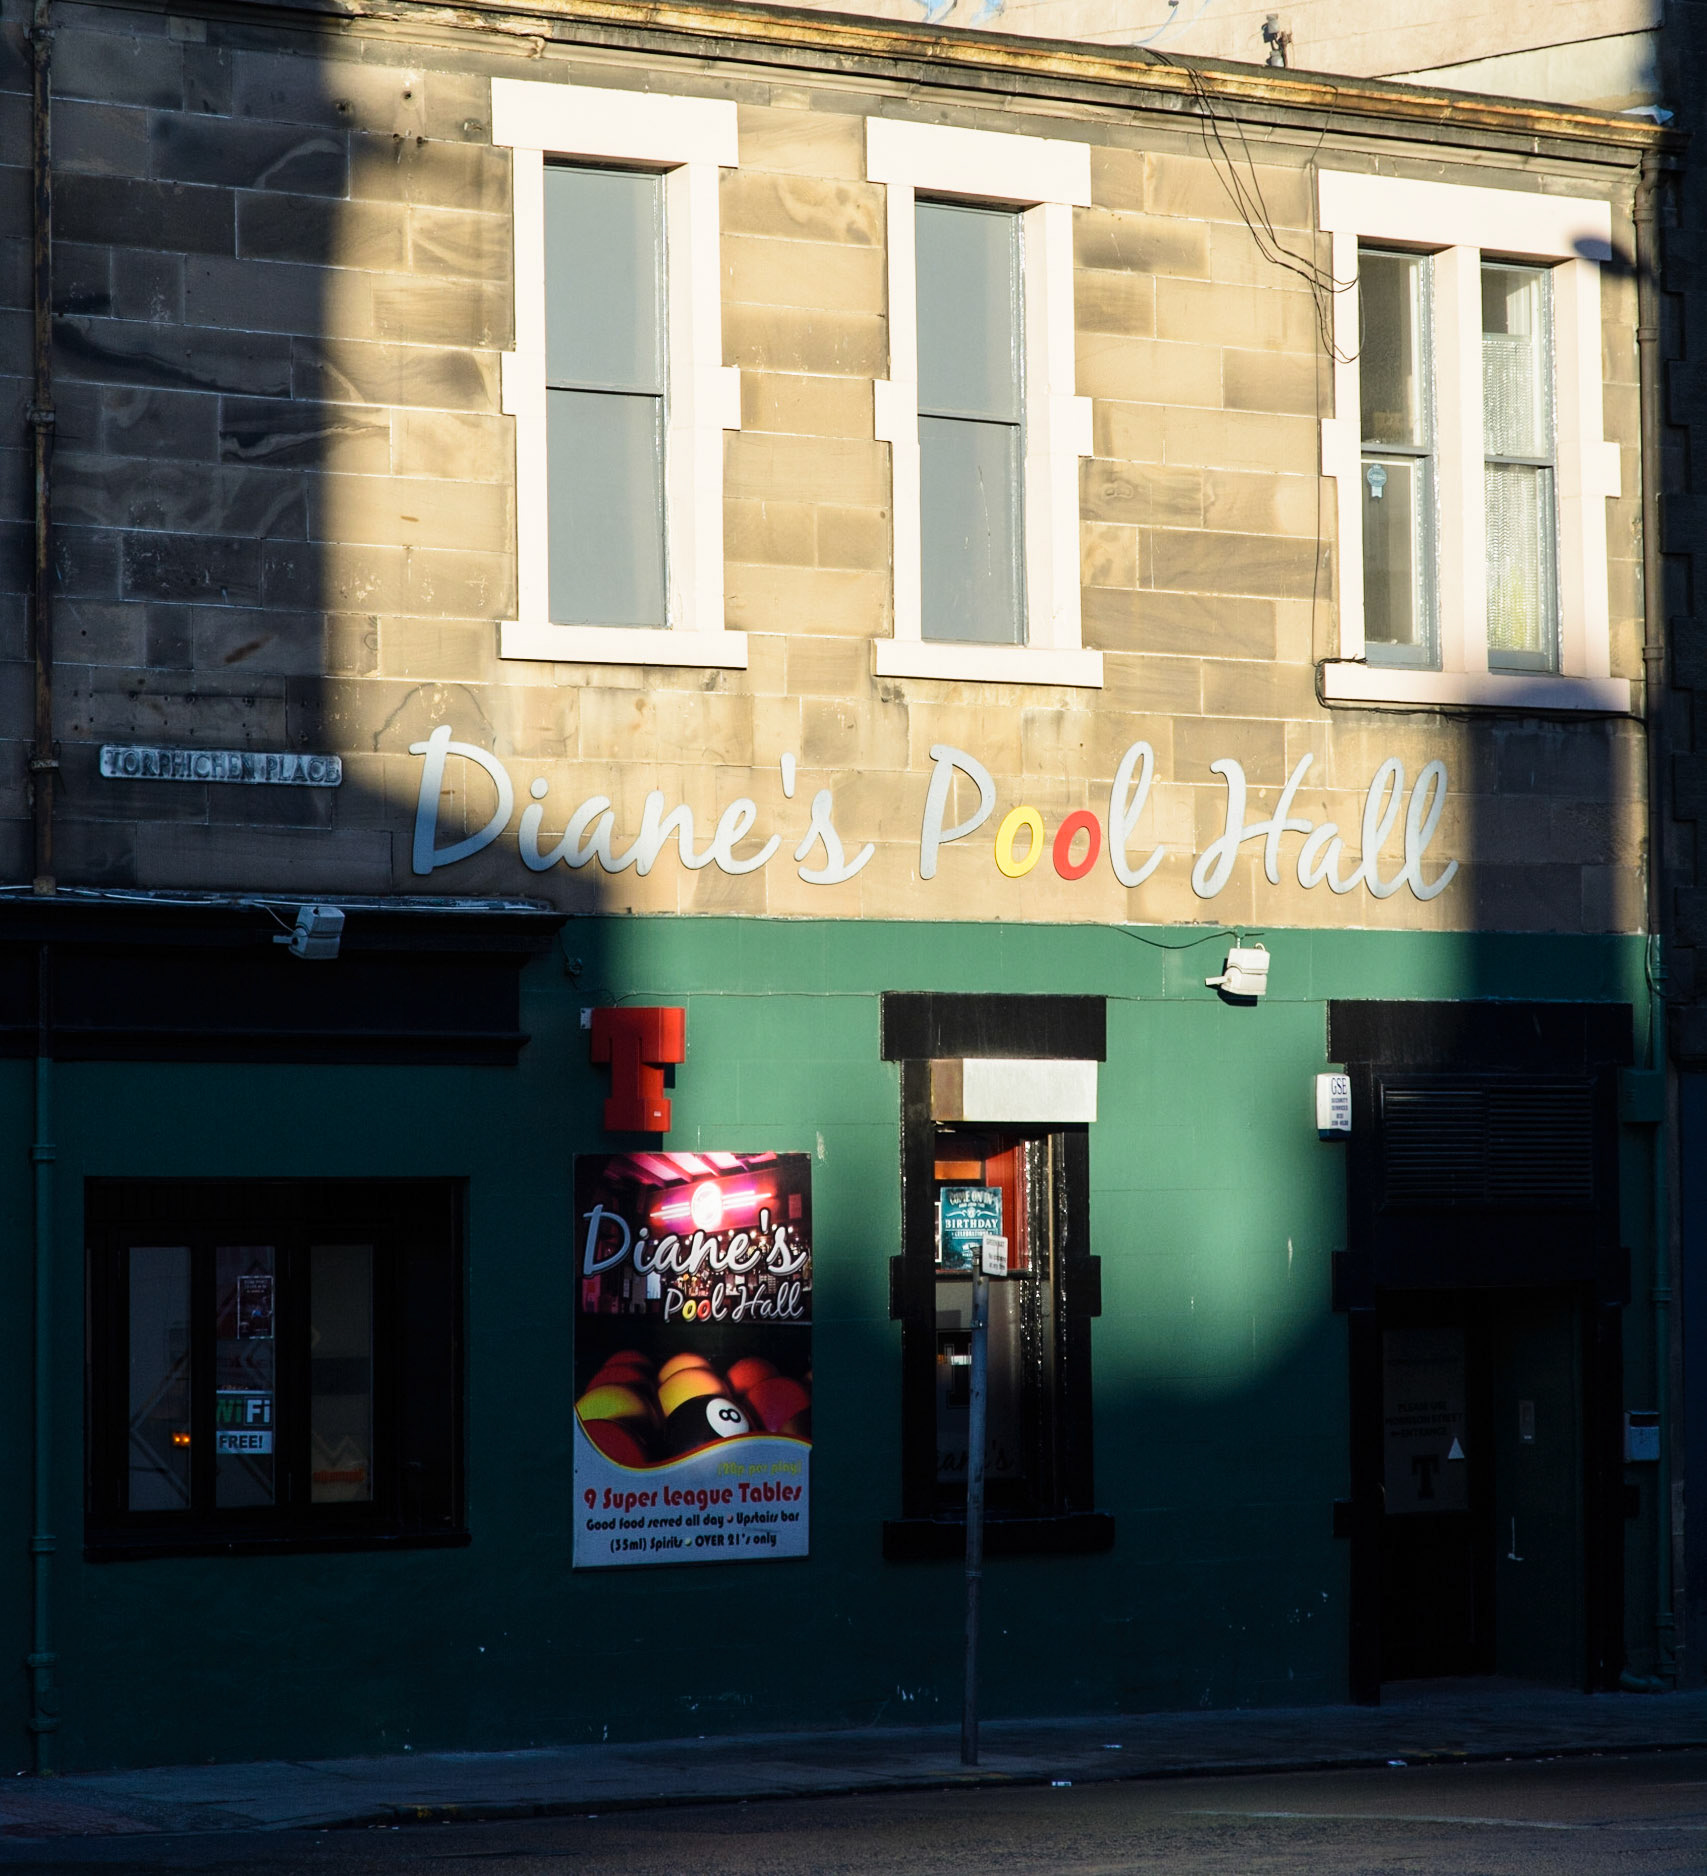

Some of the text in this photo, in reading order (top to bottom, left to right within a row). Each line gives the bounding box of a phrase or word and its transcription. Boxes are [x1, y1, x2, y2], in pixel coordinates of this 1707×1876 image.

[106, 750, 341, 784] TORPHICHEN PLACE
[408, 724, 1459, 900] Diane's Pool Hall
[1331, 1077, 1347, 1095] GSE
[945, 1218, 998, 1229] BIRTHDAY
[582, 1204, 806, 1276] Diane's
[664, 1281, 804, 1323] Pool Hall
[219, 1435, 263, 1449] FREE!
[584, 1481, 802, 1513] 9 Super League Tables
[586, 1510, 800, 1531] Good food served all day Upstairs bar
[610, 1537, 647, 1553] (35ml)
[650, 1536, 683, 1551] Spirits
[695, 1534, 724, 1547] OVER
[753, 1531, 777, 1547] only
